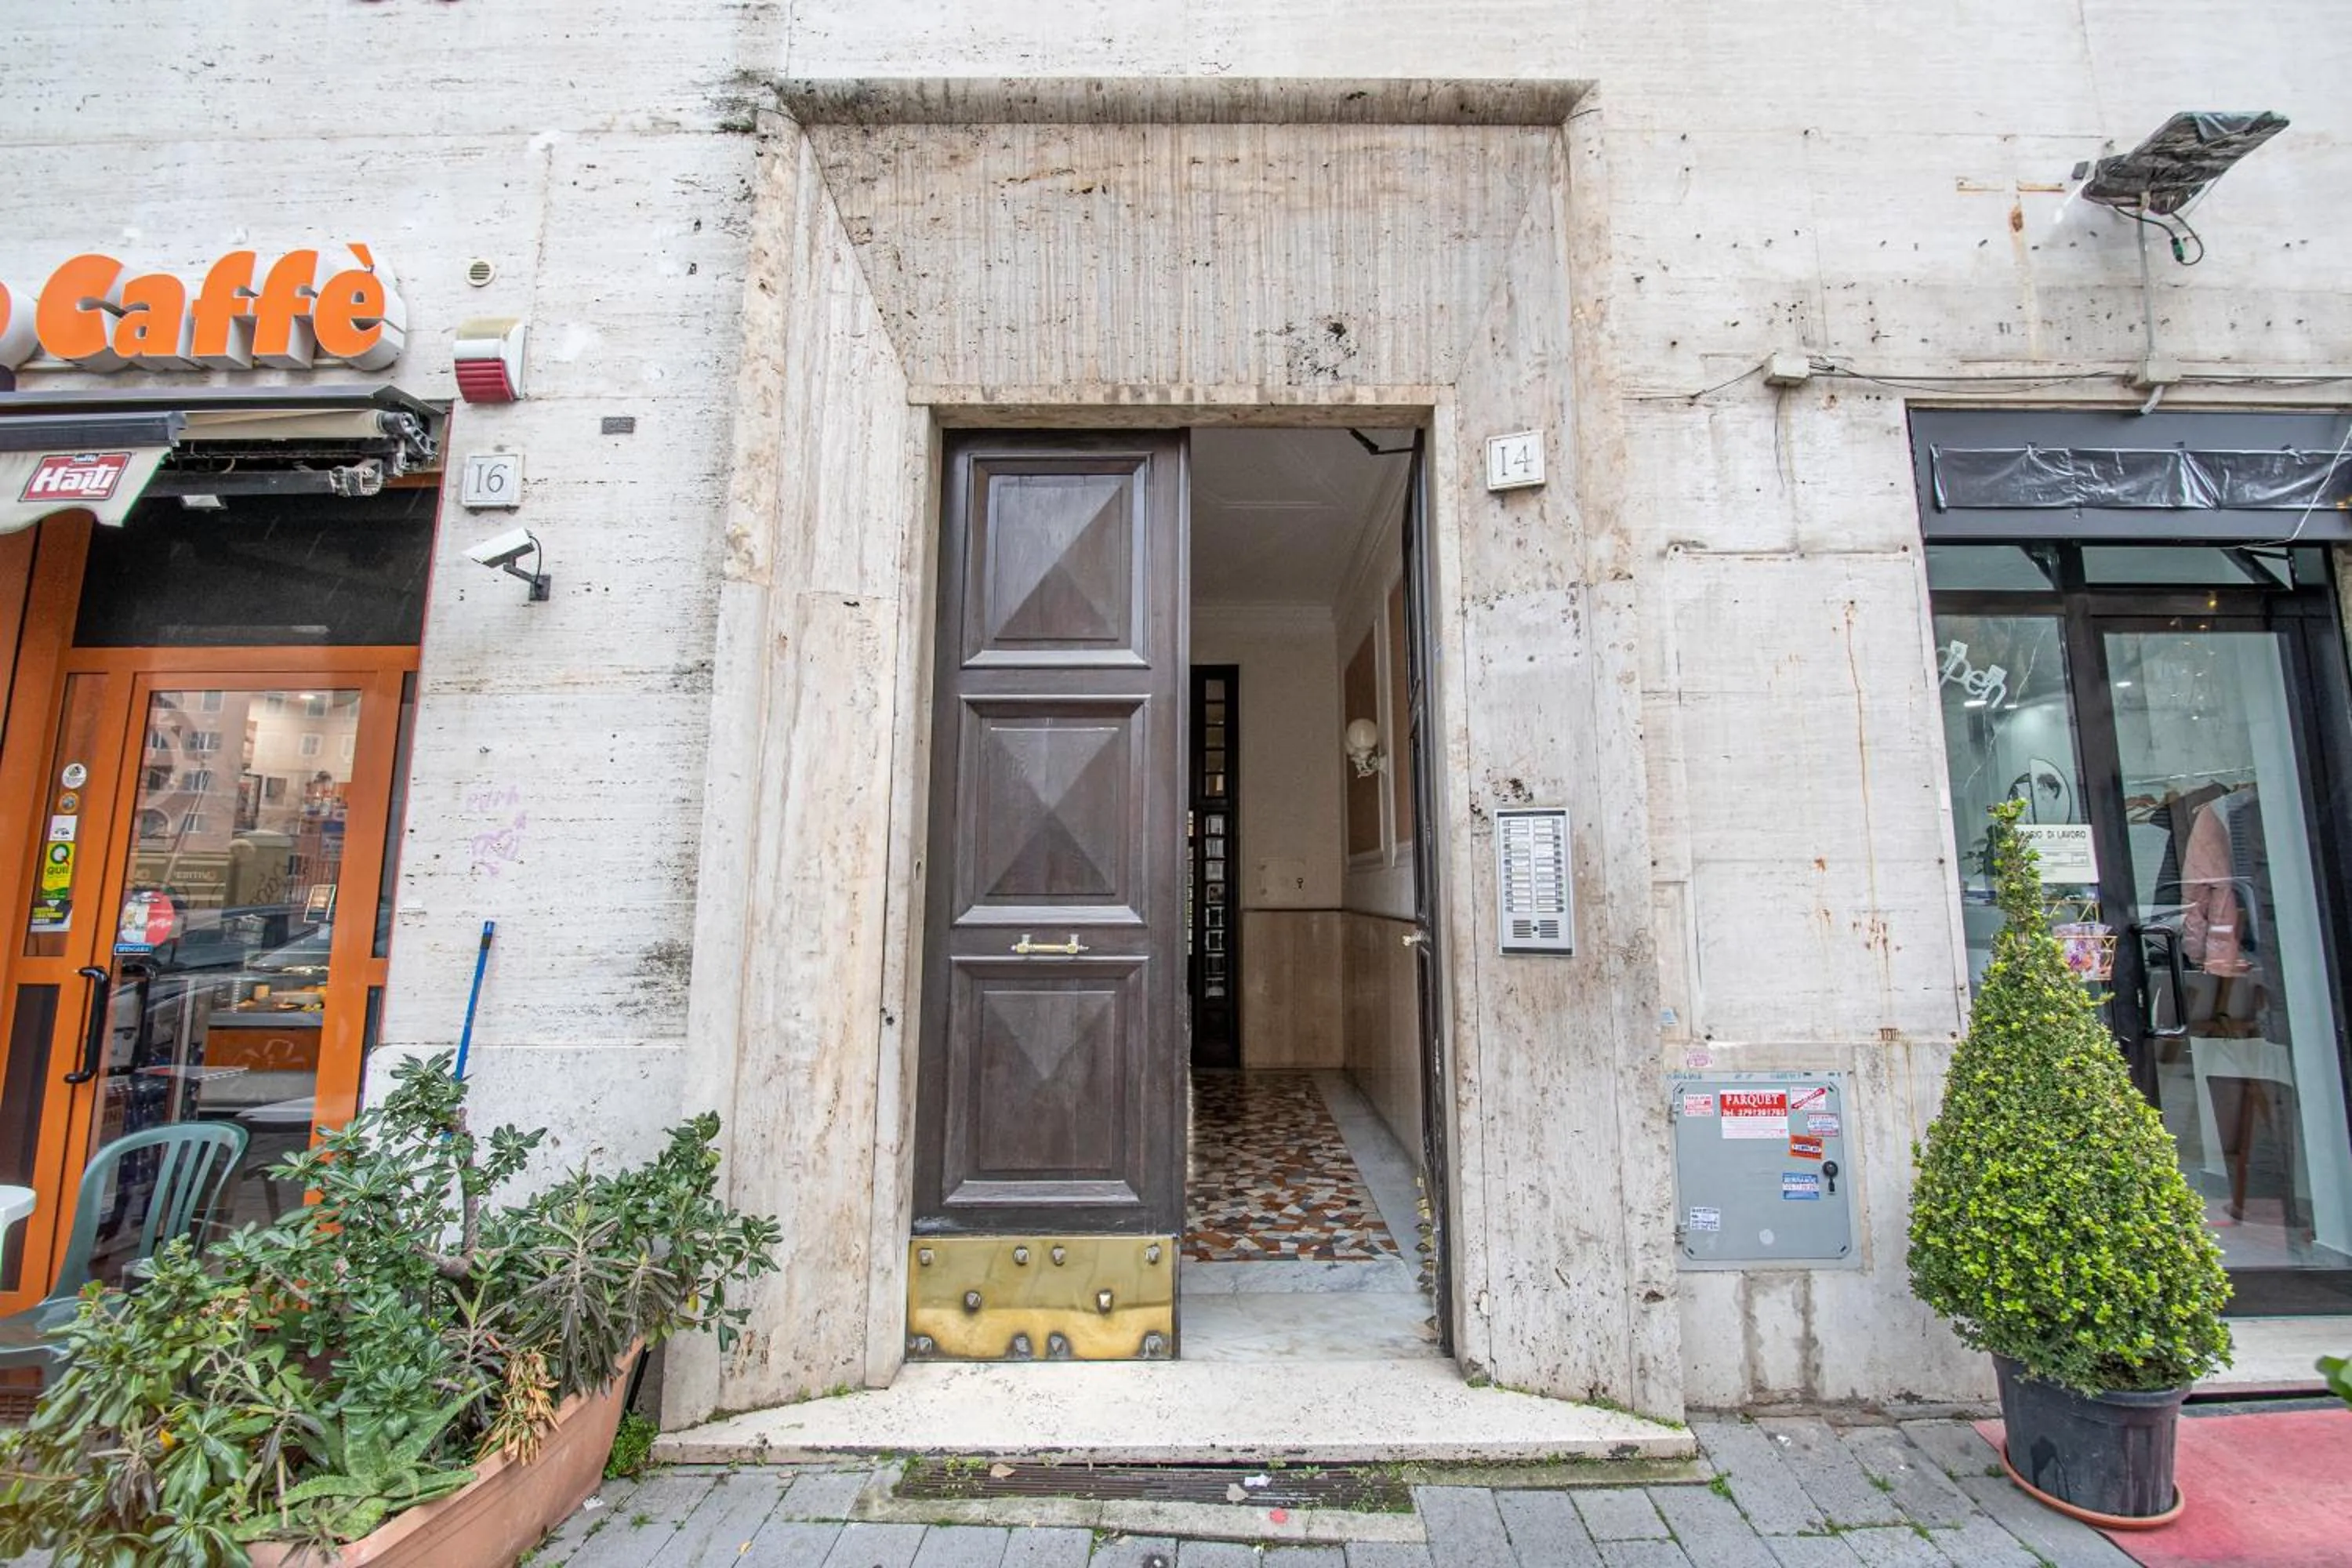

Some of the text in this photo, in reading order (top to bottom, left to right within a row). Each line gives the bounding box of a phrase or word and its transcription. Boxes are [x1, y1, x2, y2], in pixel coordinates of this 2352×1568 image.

[36, 243, 385, 359] Caffè
[1497, 445, 1534, 477] 14
[31, 463, 120, 494] Haiti
[475, 463, 509, 493] 16
[1726, 1092, 1780, 1108] PARQUET
